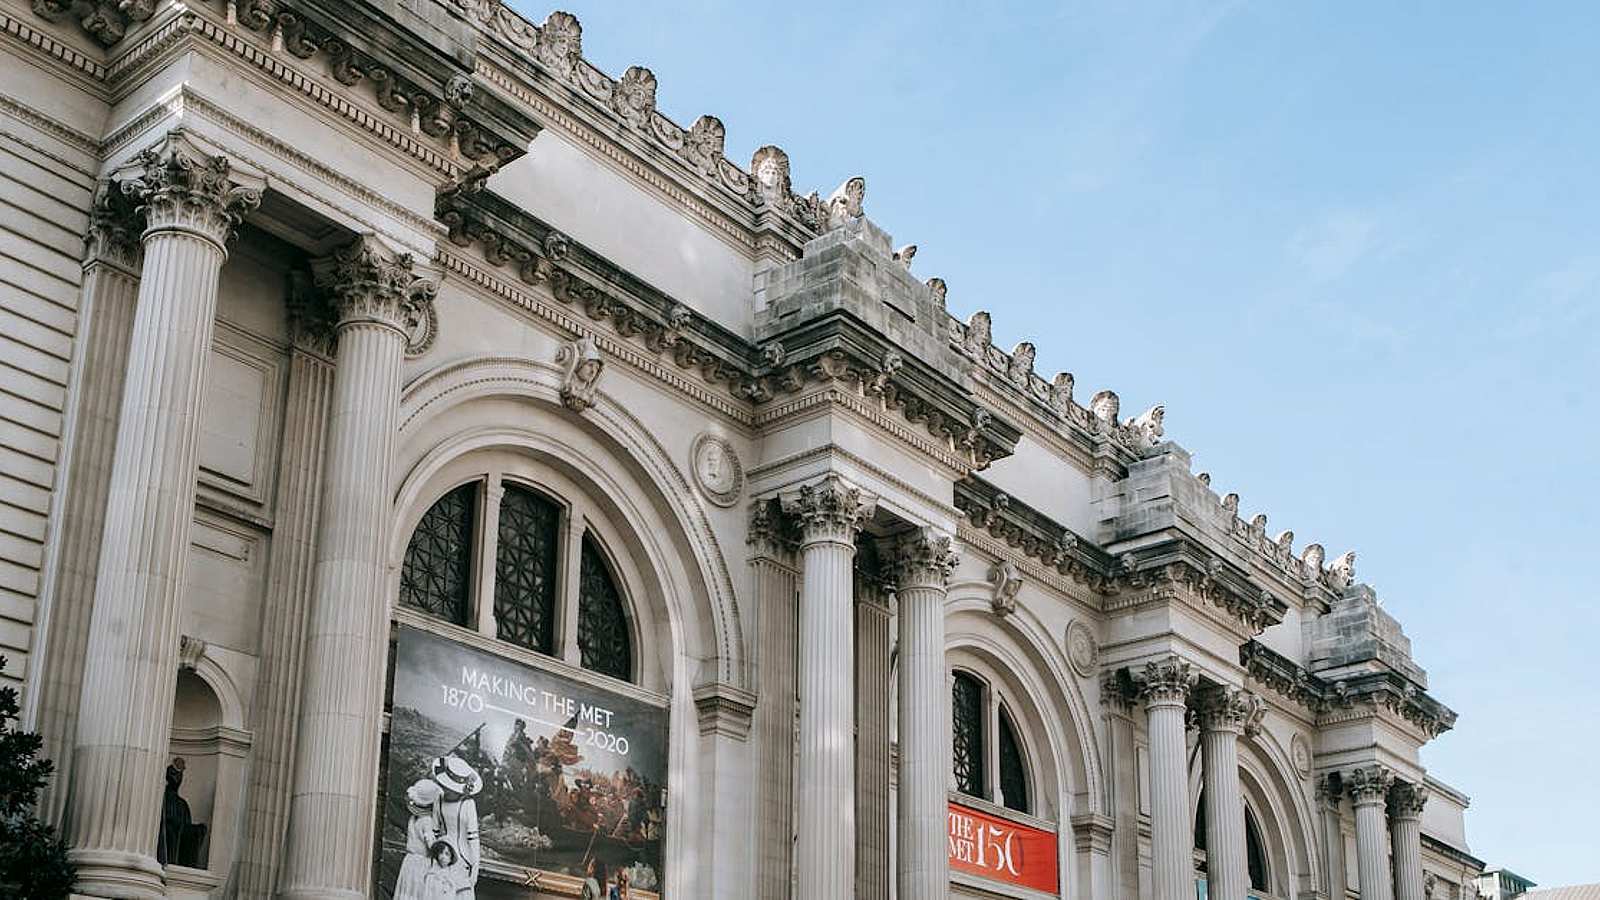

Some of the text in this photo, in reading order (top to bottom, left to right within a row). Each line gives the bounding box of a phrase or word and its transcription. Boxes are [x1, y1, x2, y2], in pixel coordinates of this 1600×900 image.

[441, 685, 629, 755] 1870 2020
[462, 666, 614, 727] MAKING THE MET
[949, 812, 974, 839] THE
[975, 822, 1024, 877] 150
